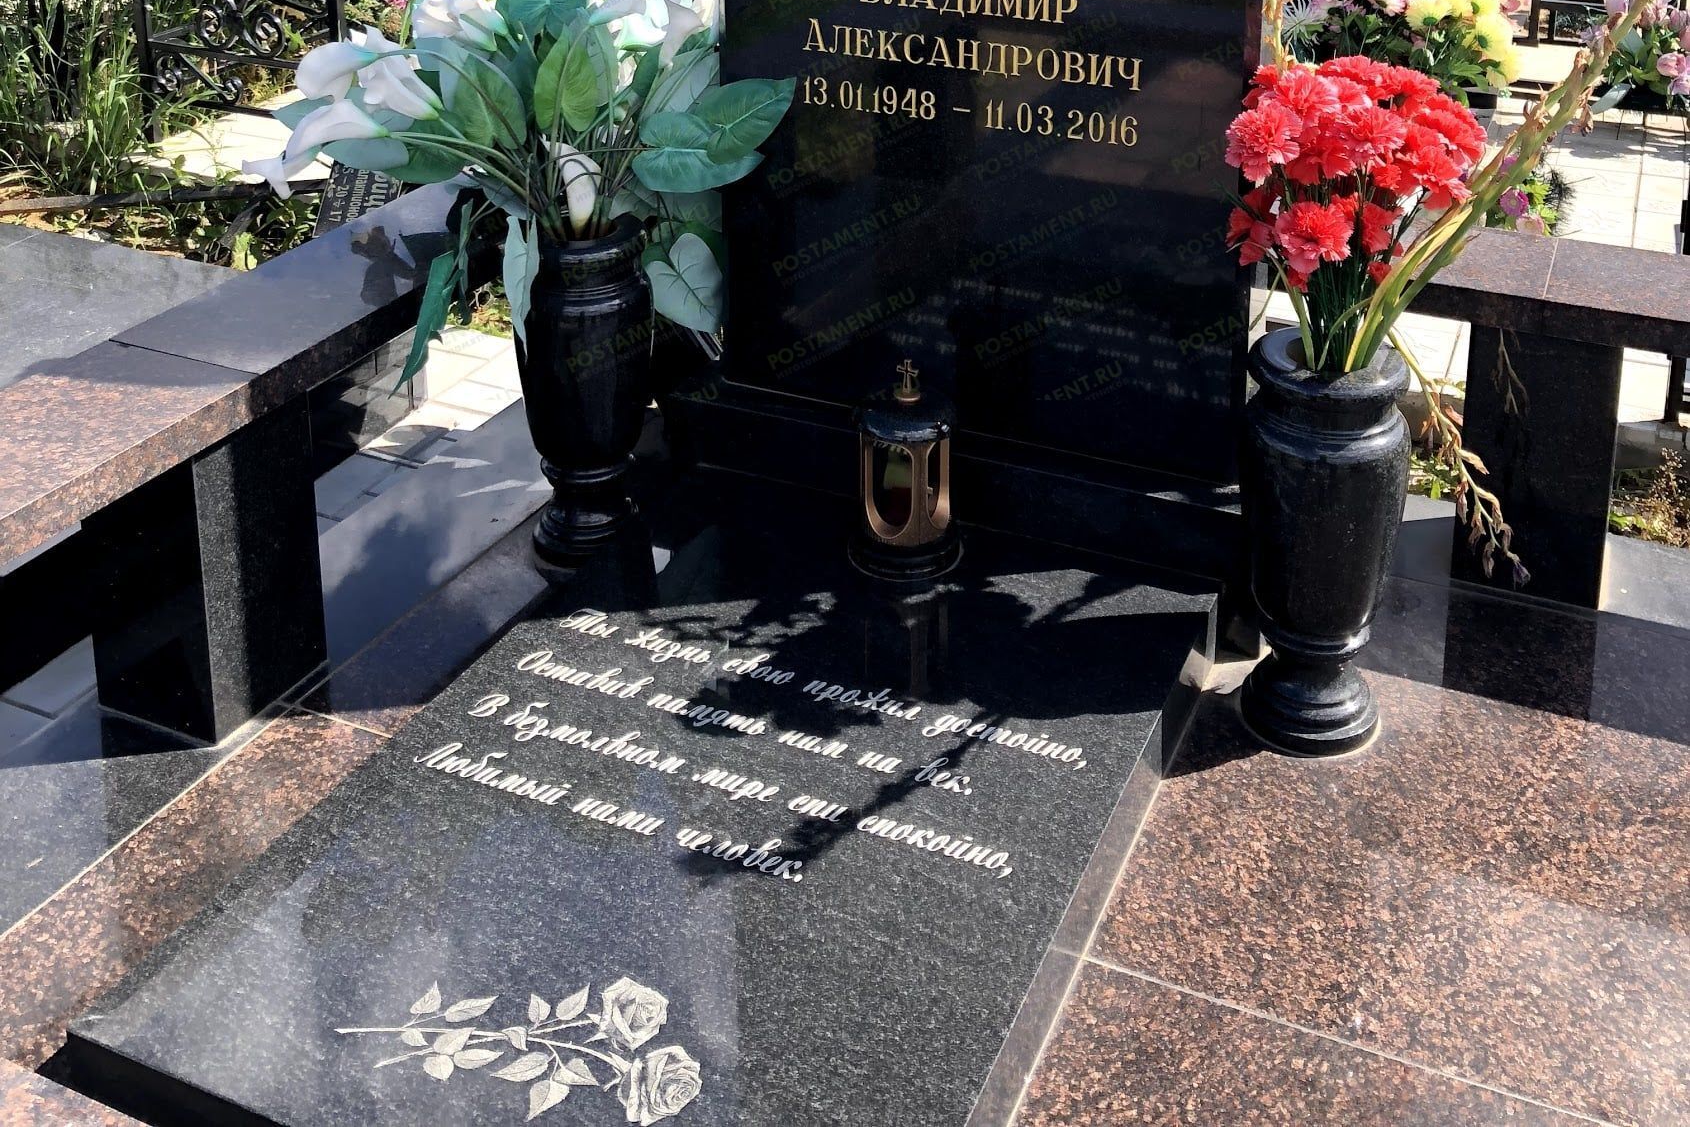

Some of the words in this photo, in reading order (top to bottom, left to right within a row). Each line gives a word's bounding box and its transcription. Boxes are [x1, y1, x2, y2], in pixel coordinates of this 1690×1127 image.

[803, 76, 936, 120] 13.01.1948
[984, 99, 1138, 147] 11.03.2016
[517, 650, 655, 699] Оставив
[646, 692, 767, 736] память
[777, 729, 849, 760] нам
[856, 750, 903, 774] на
[914, 757, 974, 795] век.
[559, 608, 620, 639] Ты
[624, 627, 712, 663] жизнь
[722, 653, 796, 685] свою
[802, 680, 922, 721] прожил
[921, 713, 1088, 771] достойно,
[413, 742, 573, 806] Любимый
[571, 798, 666, 837] нами
[675, 827, 804, 883] человек.
[467, 693, 511, 718] В
[503, 702, 686, 774] безмолвном
[691, 769, 780, 802] мире
[788, 795, 850, 822] спи
[856, 815, 1014, 879] спокойно,
